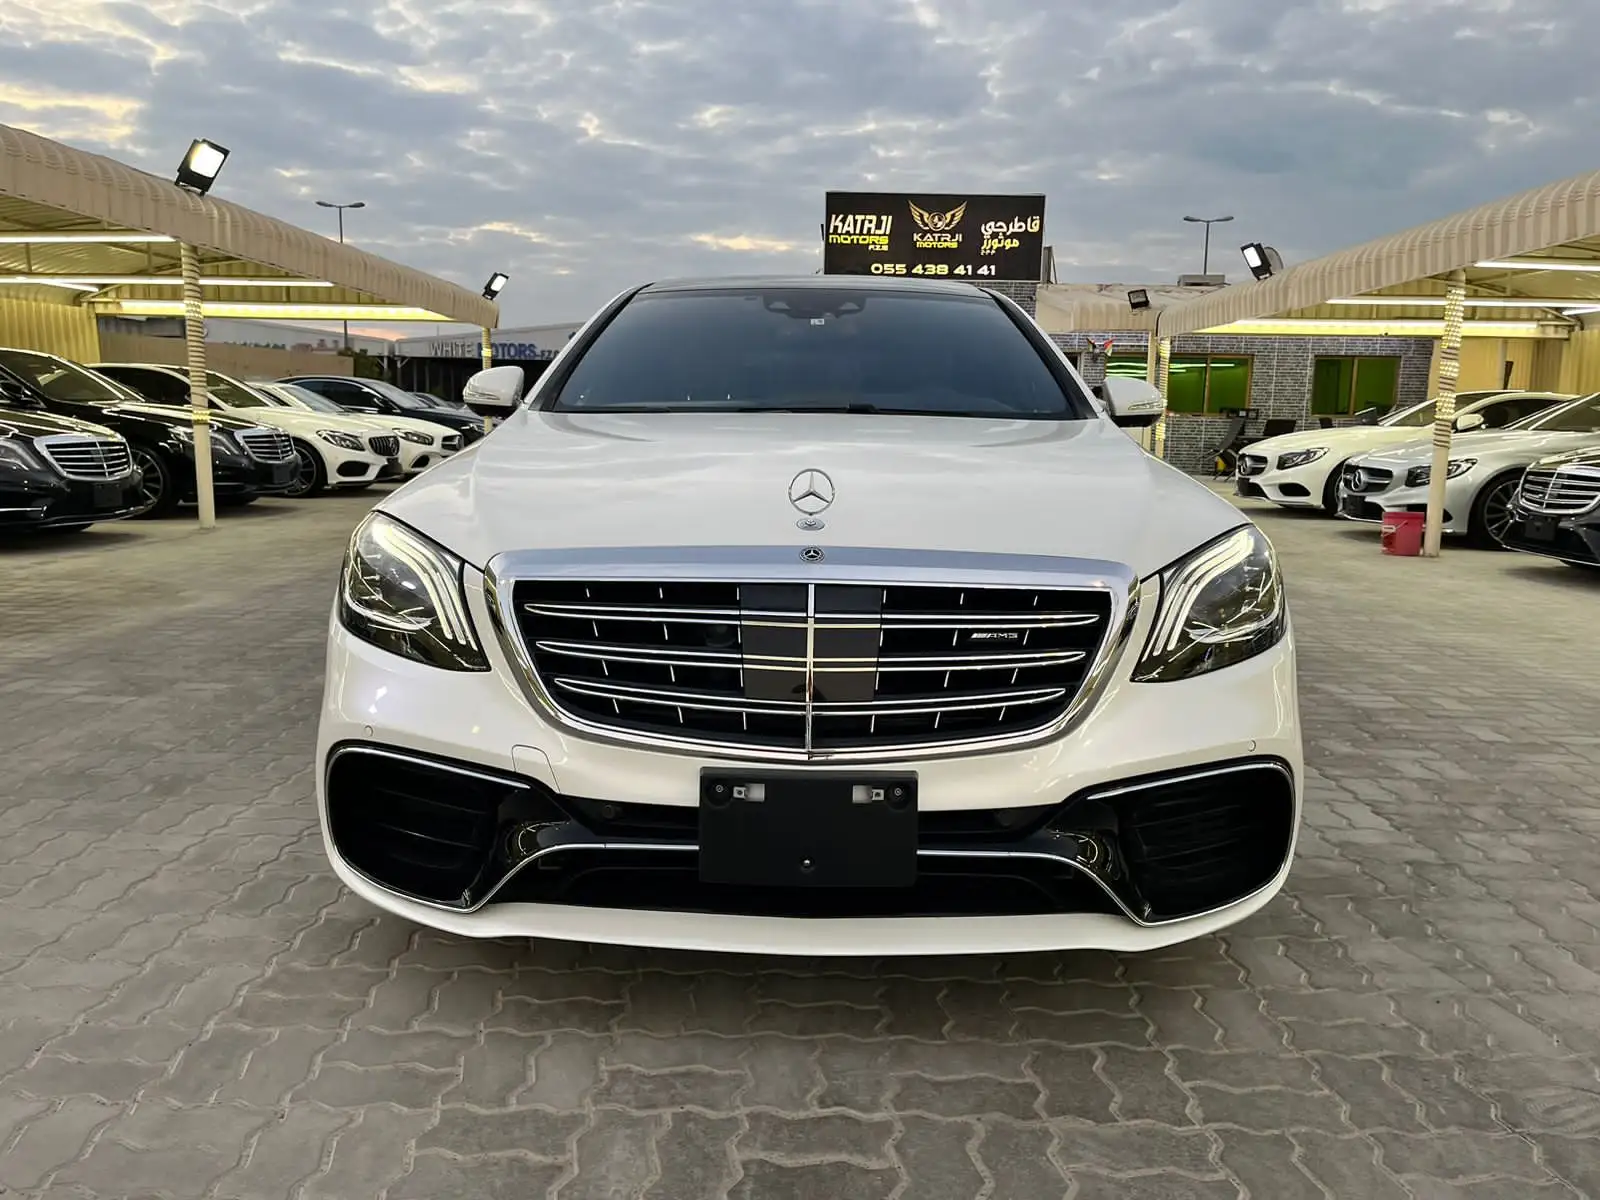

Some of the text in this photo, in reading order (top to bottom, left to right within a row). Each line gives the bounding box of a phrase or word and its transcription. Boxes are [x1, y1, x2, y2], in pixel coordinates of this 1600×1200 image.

[829, 214, 893, 235] KATRJI
[980, 215, 1041, 239] قاطرجي
[829, 235, 889, 245] MOTORS
[913, 233, 963, 242] KATRJI
[870, 263, 996, 276] 055 438 41 41
[430, 341, 475, 357] WHITE
